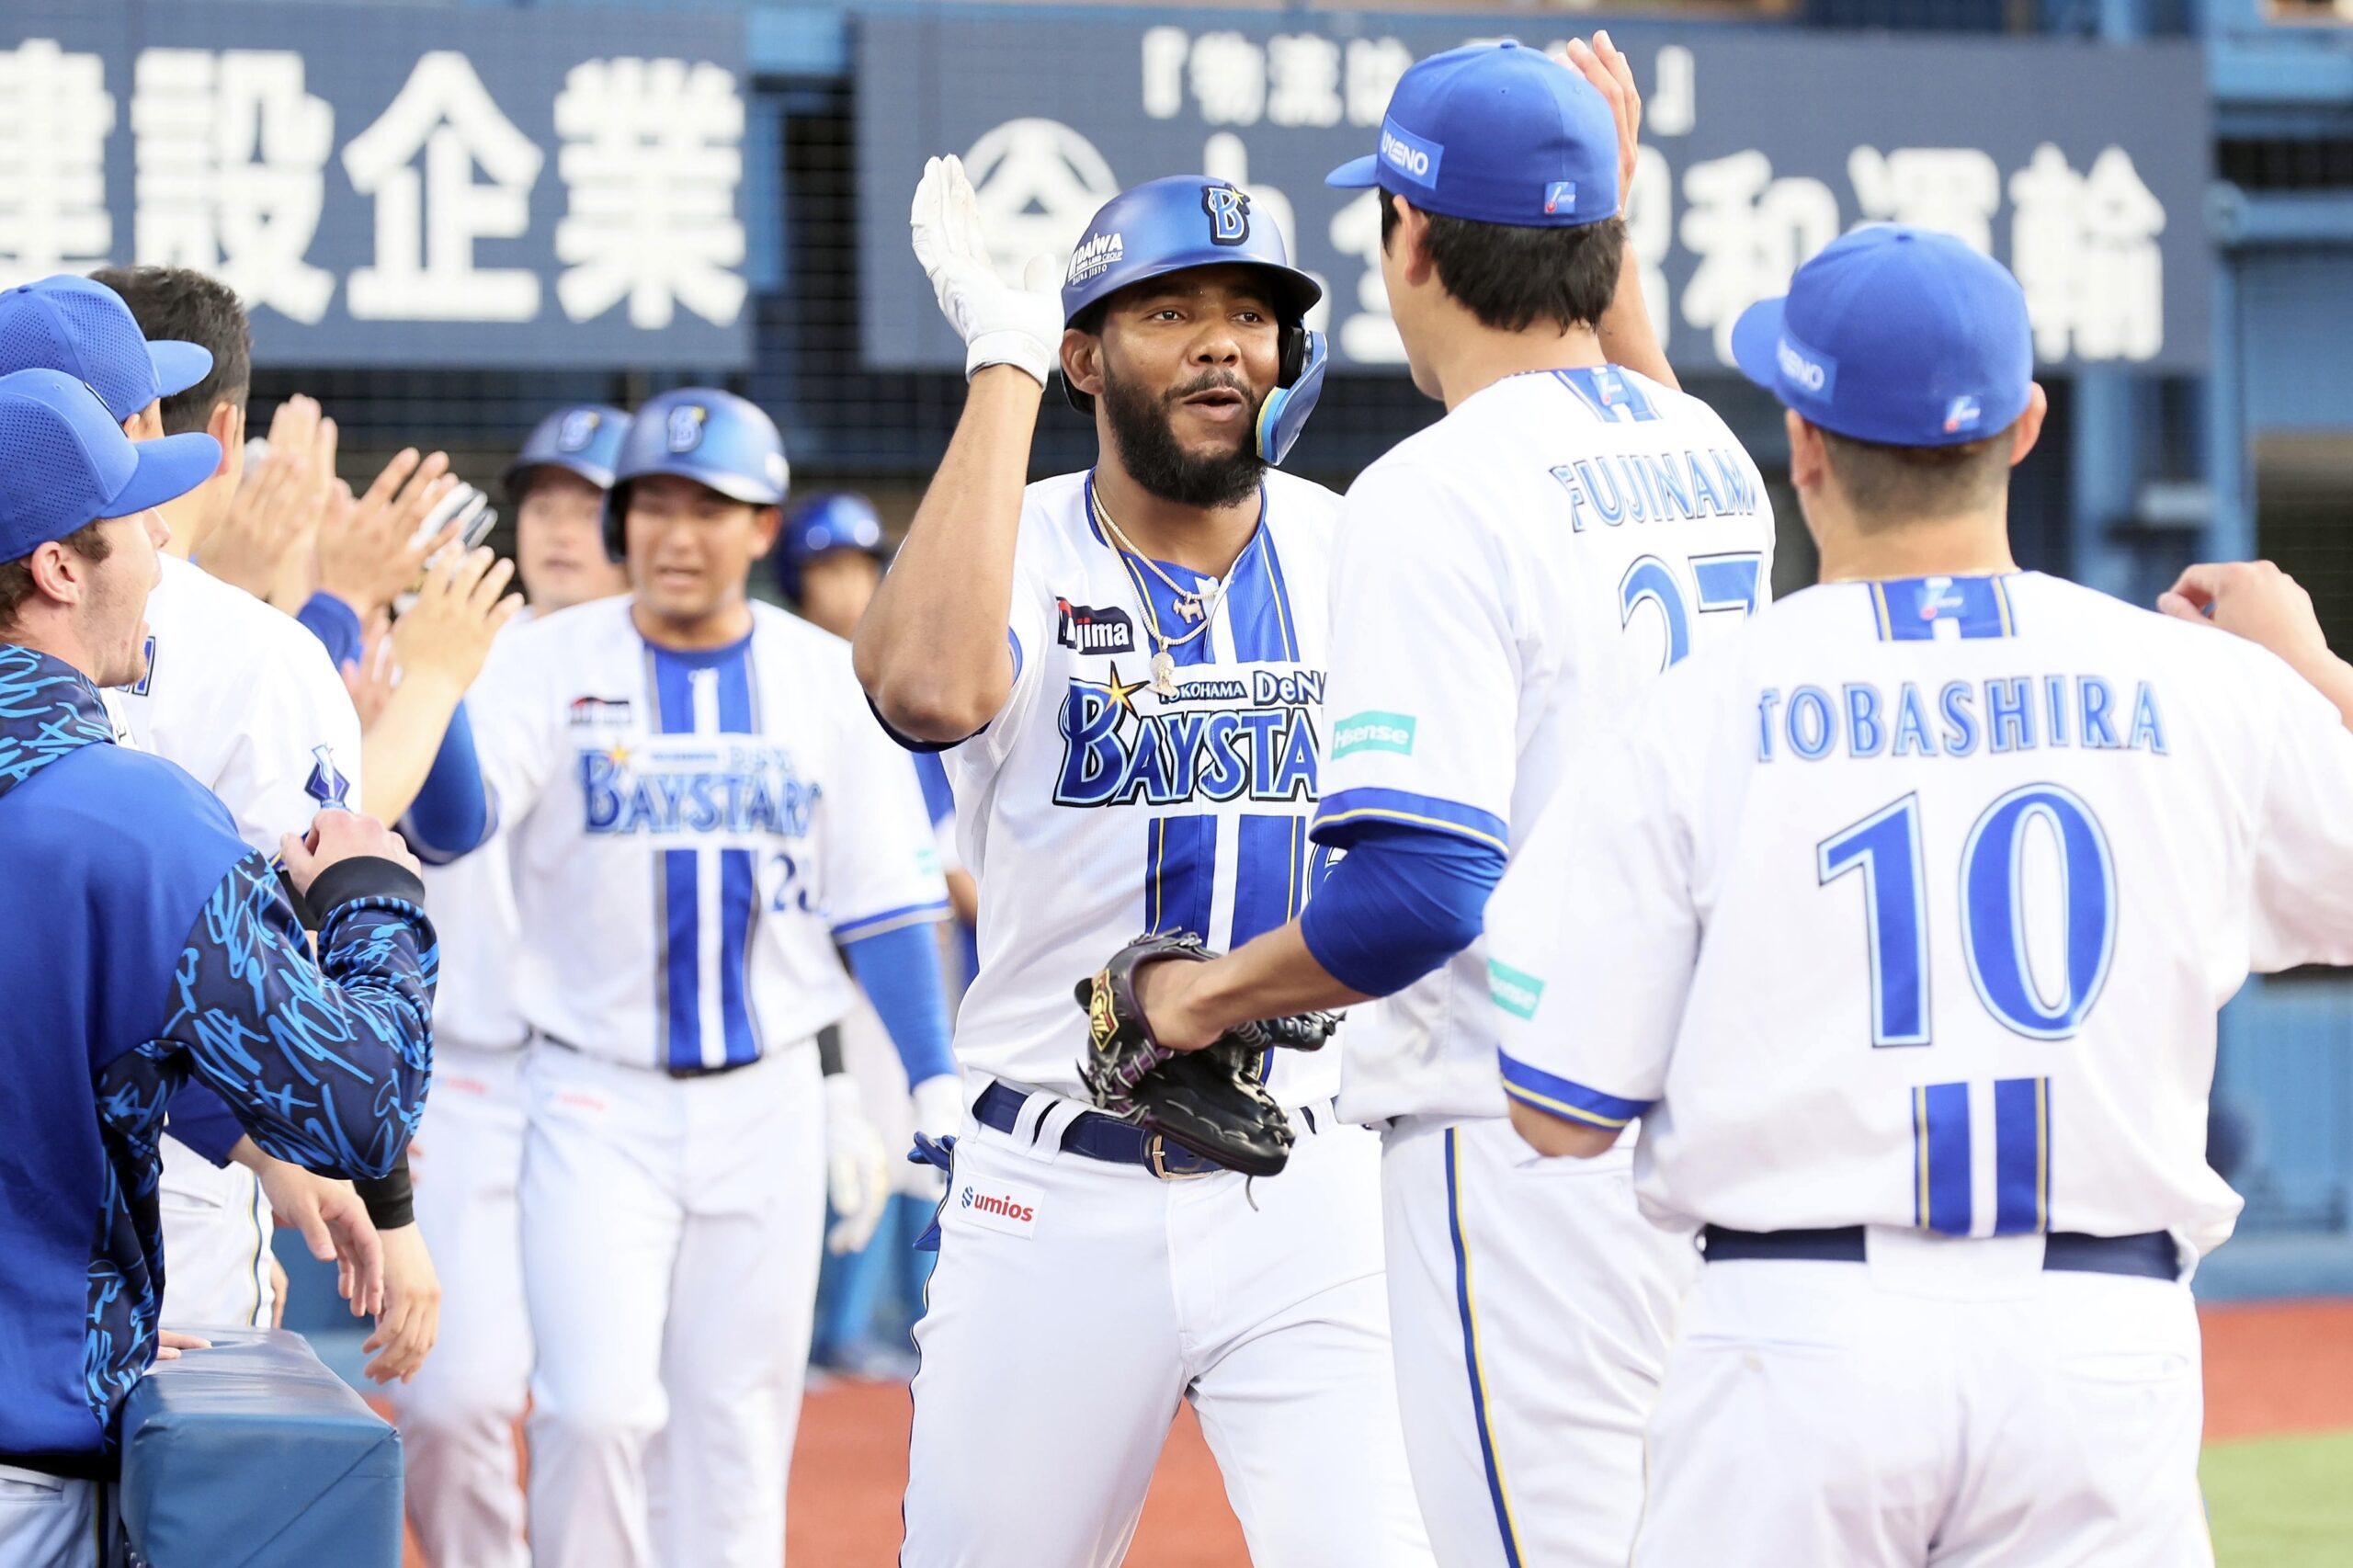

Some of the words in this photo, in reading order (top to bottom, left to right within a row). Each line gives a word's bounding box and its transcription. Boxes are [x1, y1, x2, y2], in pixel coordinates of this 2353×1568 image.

[1204, 184, 1248, 244] B
[1550, 449, 1756, 533] FUJINAM
[1253, 670, 1326, 706] DeN
[1757, 674, 2171, 763] TOBASHIRA
[1052, 676, 1321, 807] BAYSTA
[1816, 782, 2118, 1048] 10
